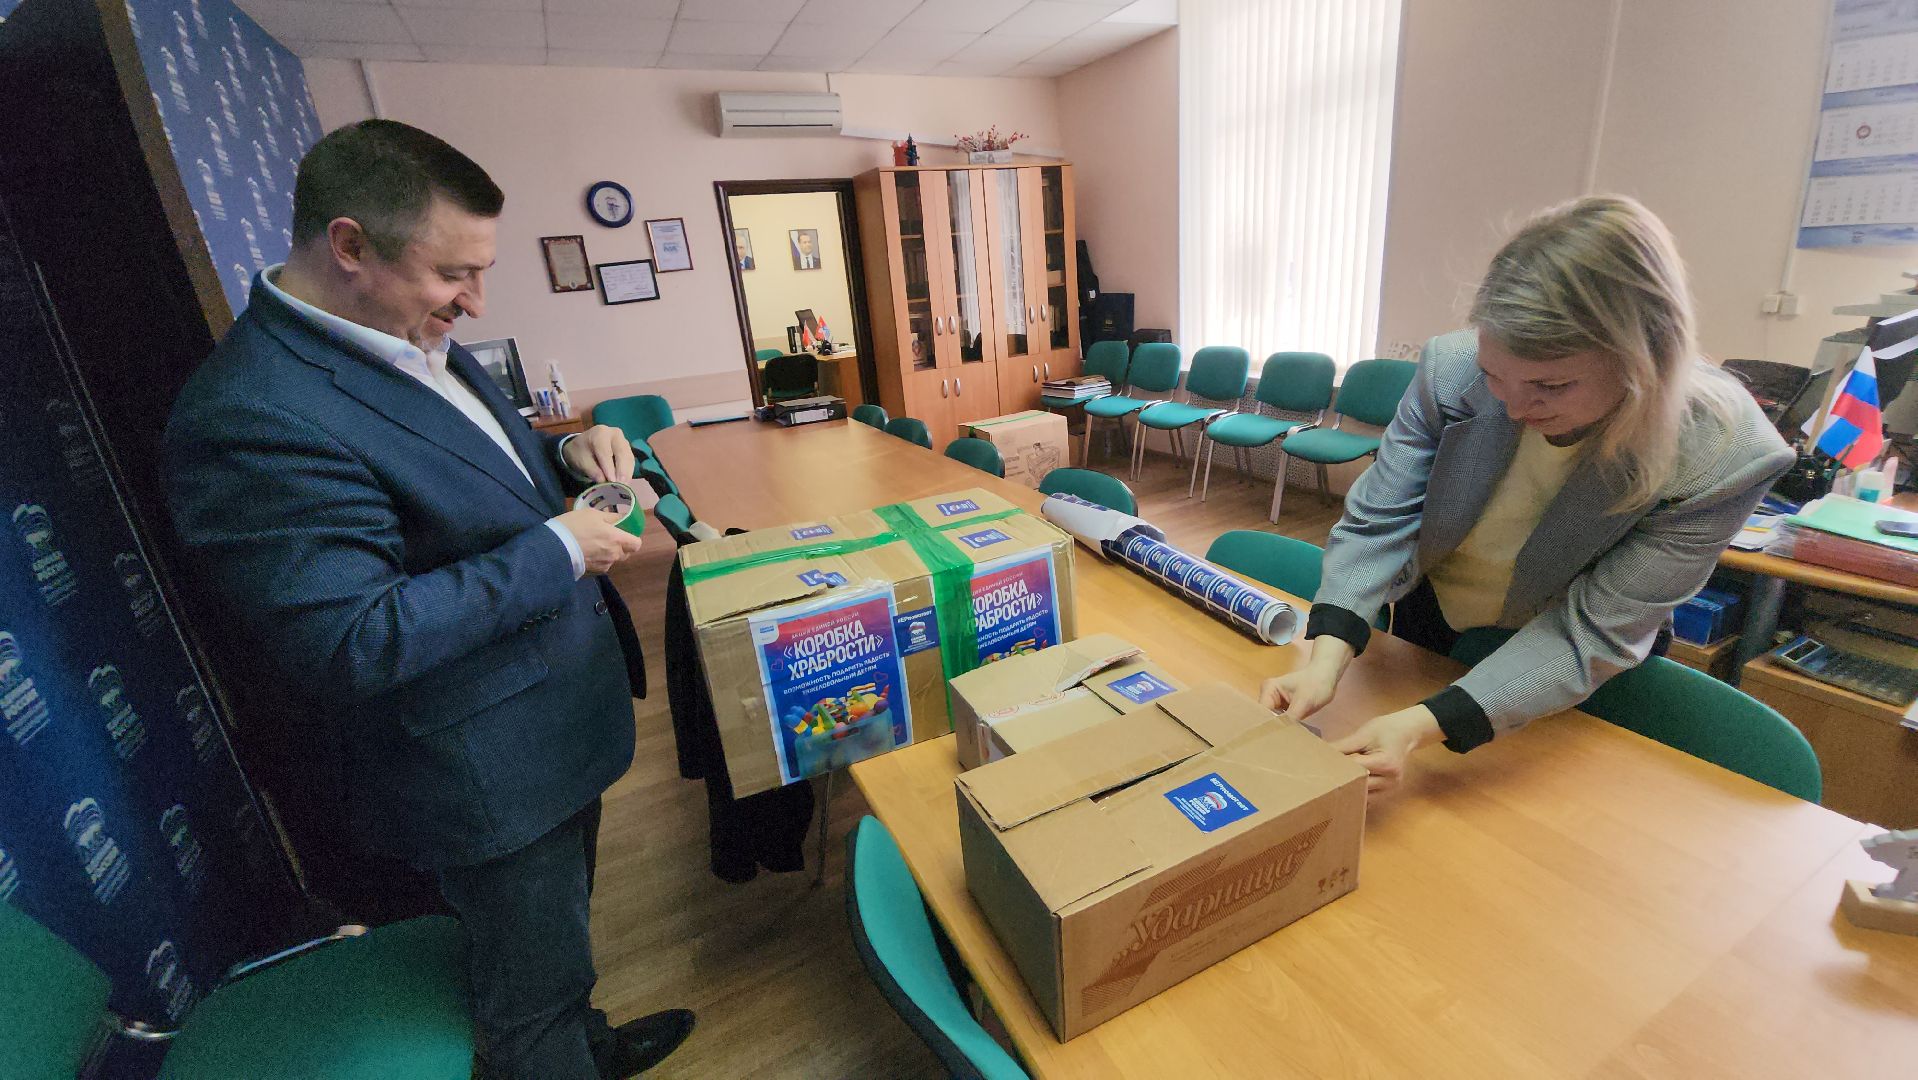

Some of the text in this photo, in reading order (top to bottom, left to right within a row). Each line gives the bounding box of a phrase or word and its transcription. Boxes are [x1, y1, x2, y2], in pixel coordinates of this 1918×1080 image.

[967, 593, 1043, 634] РАБРОСТИ»
[783, 619, 866, 660] «КОРОБКА
[787, 634, 884, 681] ХРАБРОСТИ»
[783, 674, 832, 695] ВОЗМОЖНОСТЬ
[831, 662, 864, 679] ПОДАРИТЬ
[1130, 848, 1298, 948] Ударница
